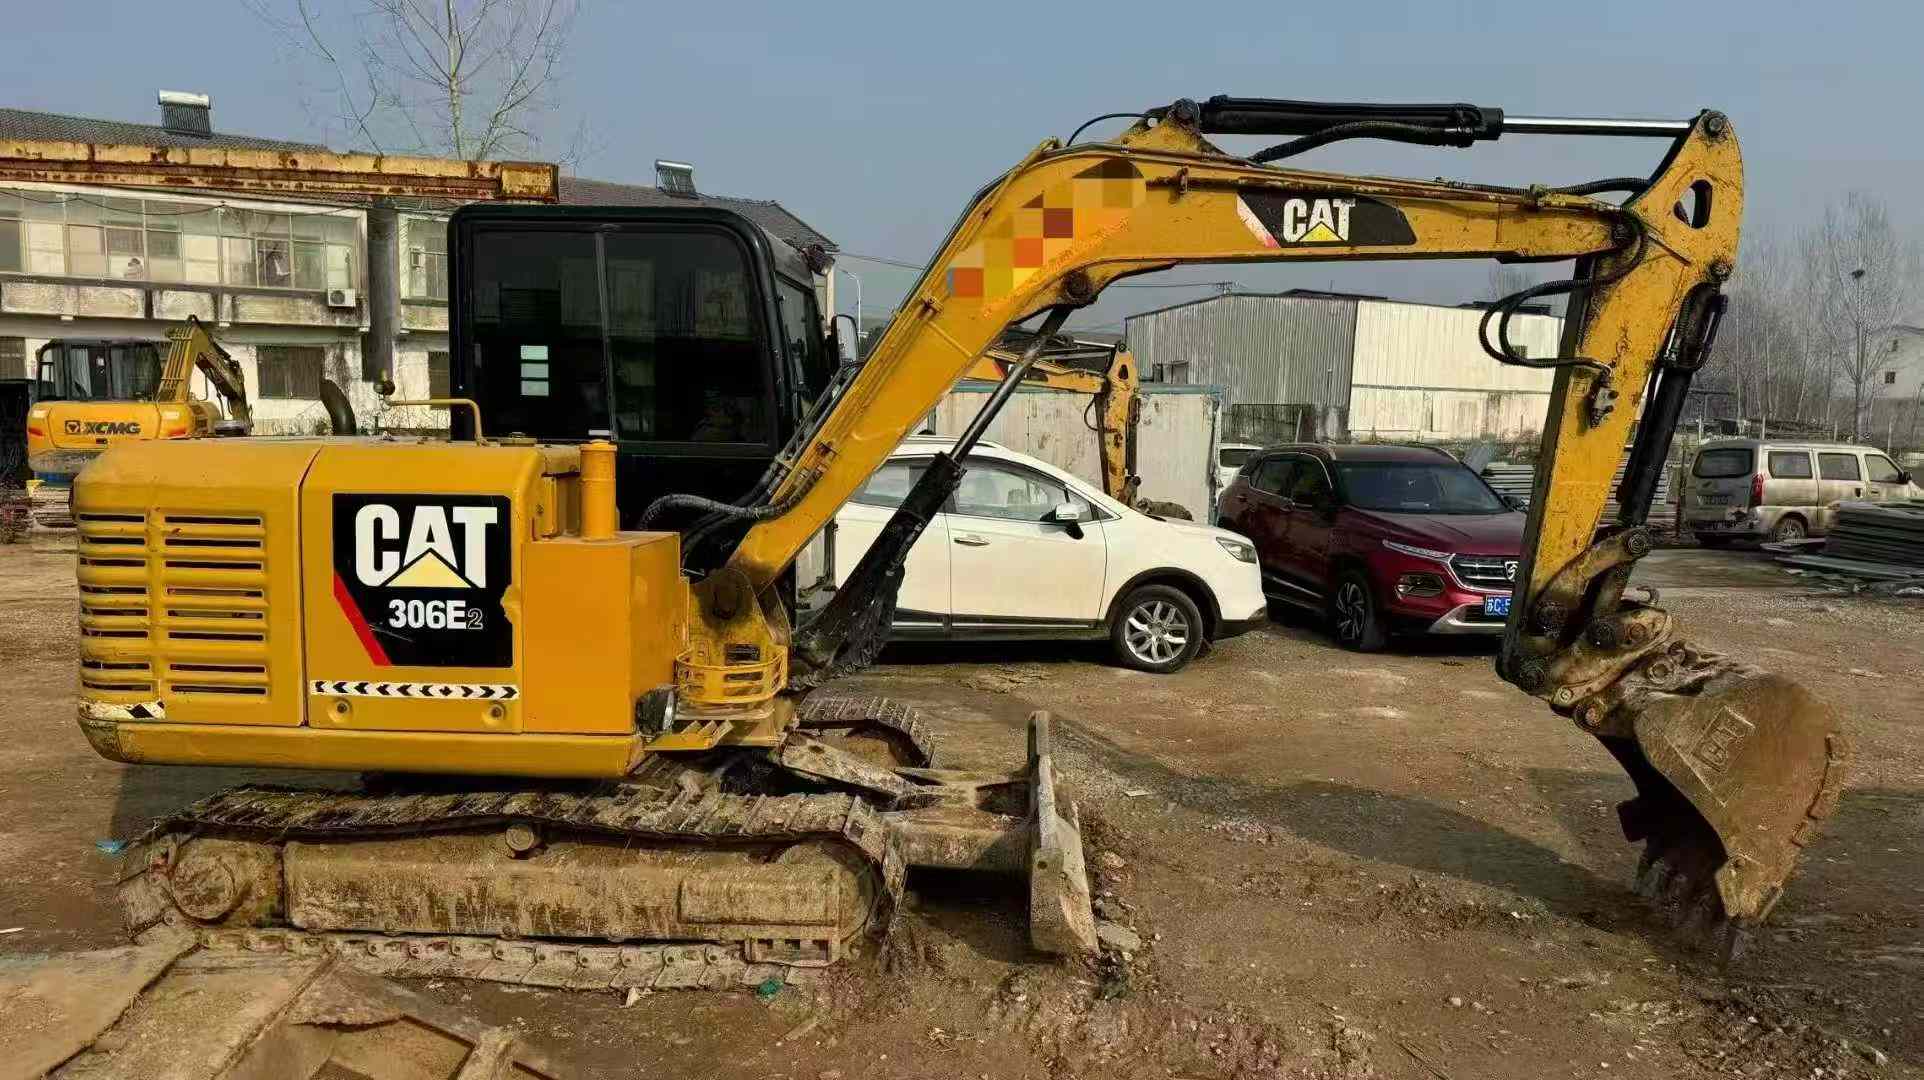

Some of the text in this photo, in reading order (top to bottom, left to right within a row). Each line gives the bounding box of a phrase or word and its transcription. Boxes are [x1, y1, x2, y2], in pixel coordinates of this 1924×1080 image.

[1283, 198, 1356, 242] CAT
[84, 422, 141, 434] XCMG
[355, 504, 498, 588] CAT
[389, 599, 484, 630] 306E2
